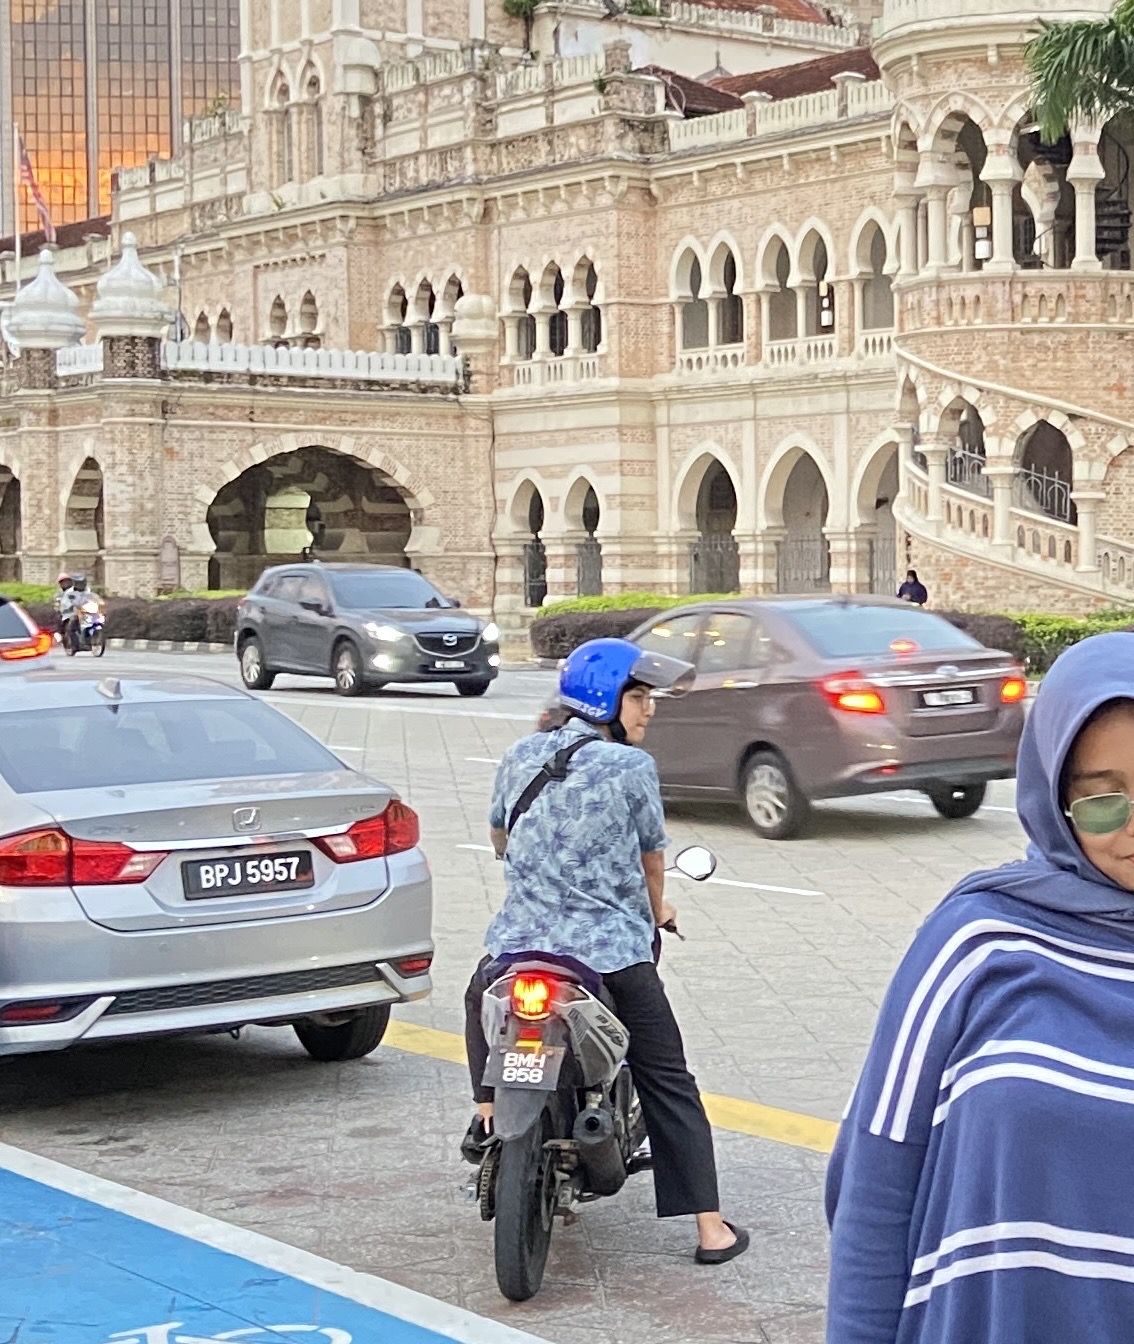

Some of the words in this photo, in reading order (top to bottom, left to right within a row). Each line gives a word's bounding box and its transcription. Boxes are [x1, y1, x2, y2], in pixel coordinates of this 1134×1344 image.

[199, 862, 242, 889] BPJ
[246, 857, 300, 884] 5957
[503, 1052, 546, 1068] BMH
[502, 1067, 544, 1084] 858
